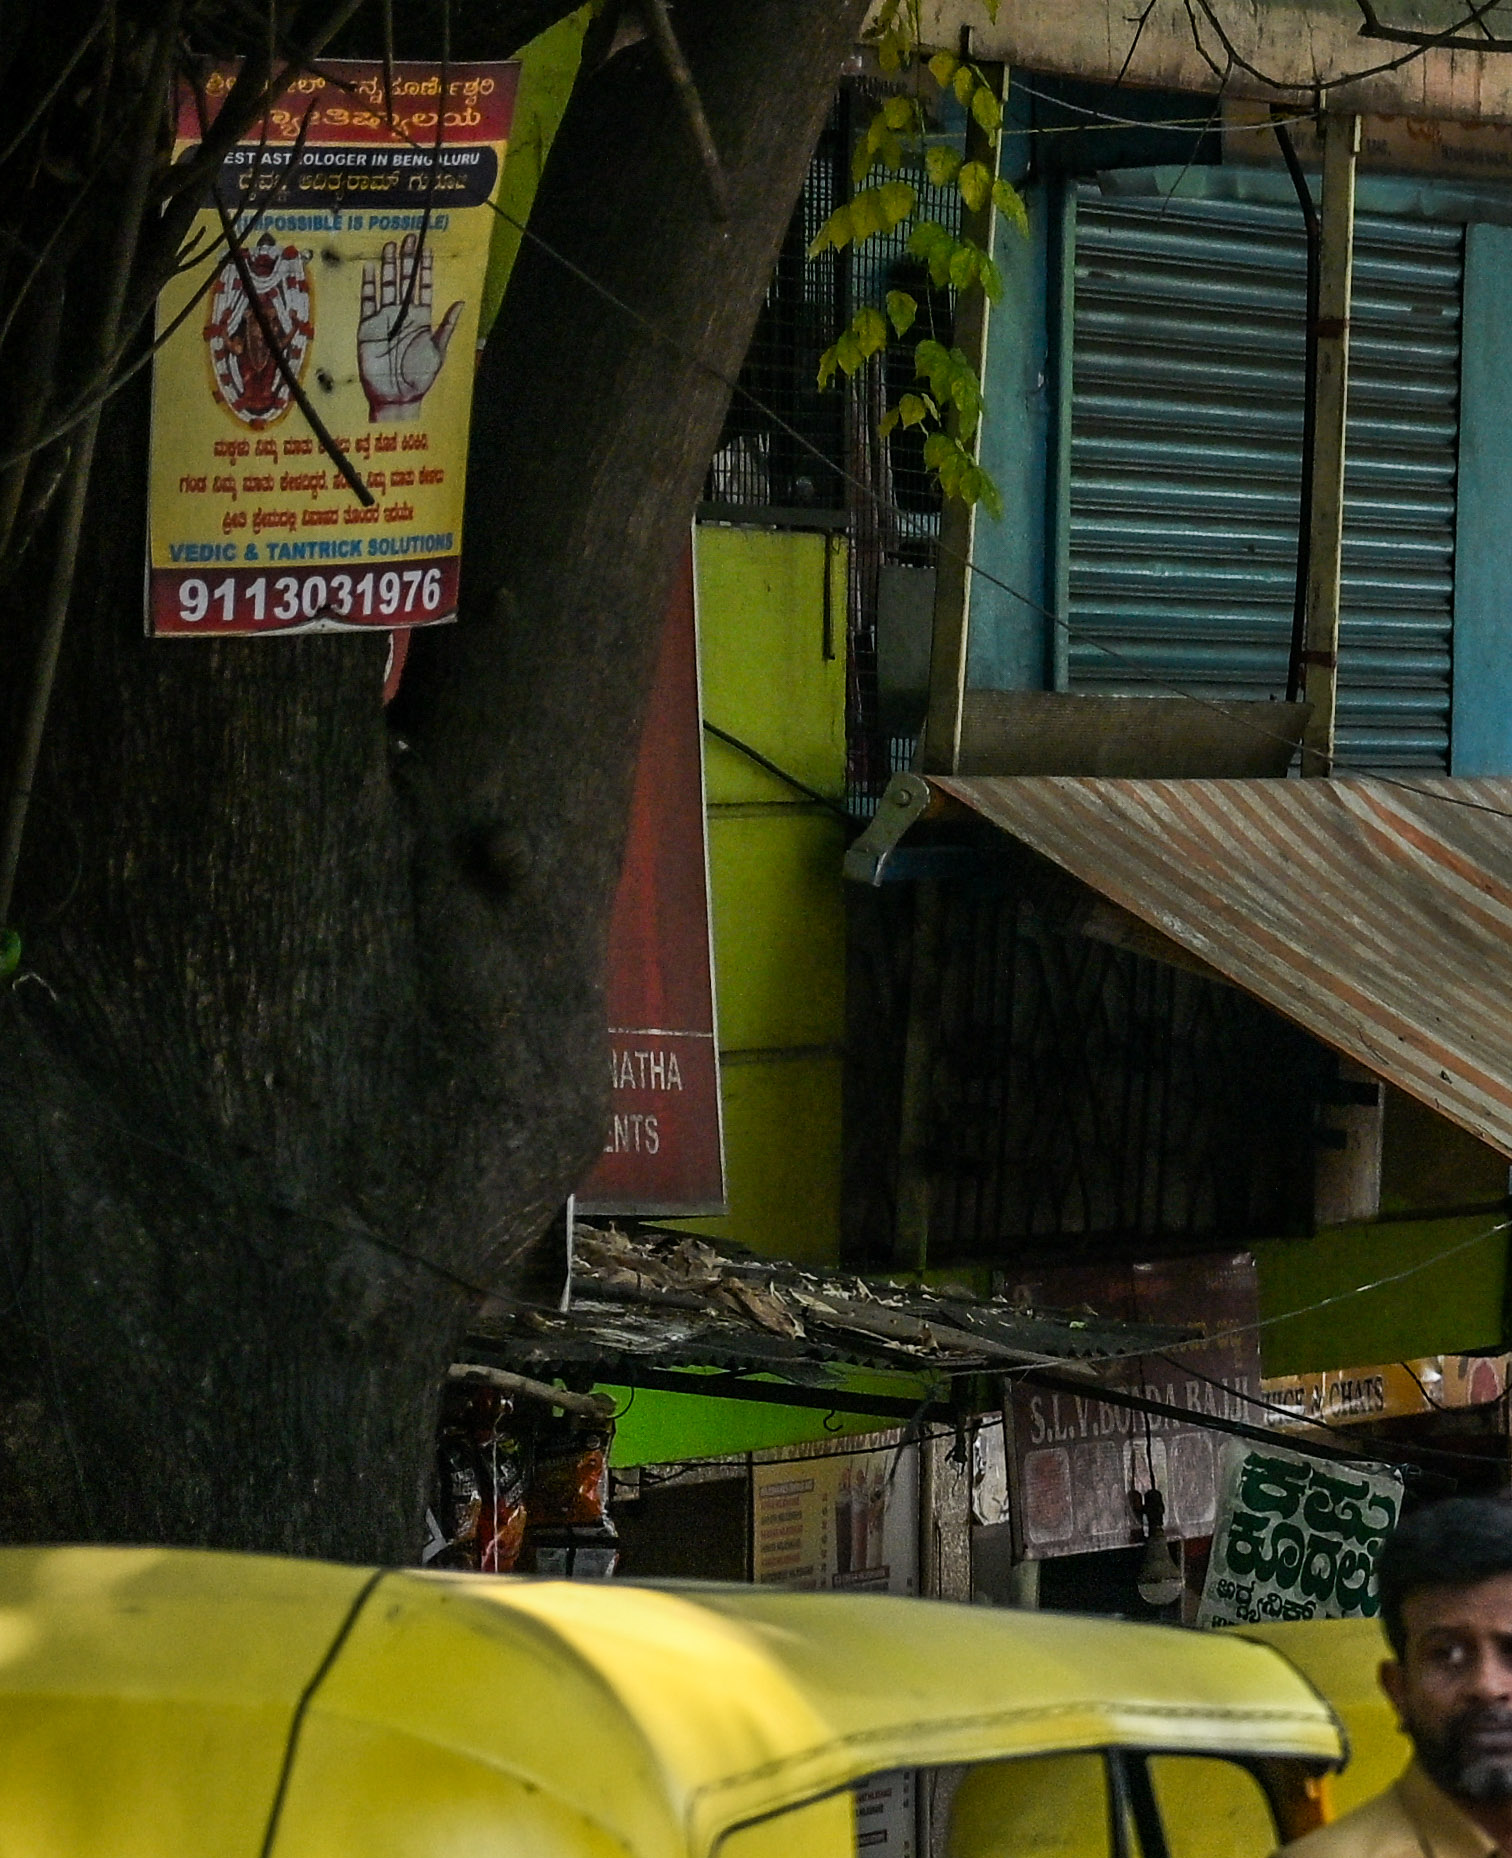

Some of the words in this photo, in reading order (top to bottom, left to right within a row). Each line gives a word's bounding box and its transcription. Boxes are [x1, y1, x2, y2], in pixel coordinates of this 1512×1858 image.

[223, 152, 255, 165] EST
[261, 152, 366, 166] ASTOLOGER
[372, 152, 392, 166] IN
[392, 151, 480, 167] BENGLURU
[169, 541, 237, 564] VEDIC
[244, 542, 260, 562] &
[266, 538, 363, 563] TANTRICK
[367, 532, 454, 558] SOLUTIONS
[178, 567, 442, 623] 9113031976
